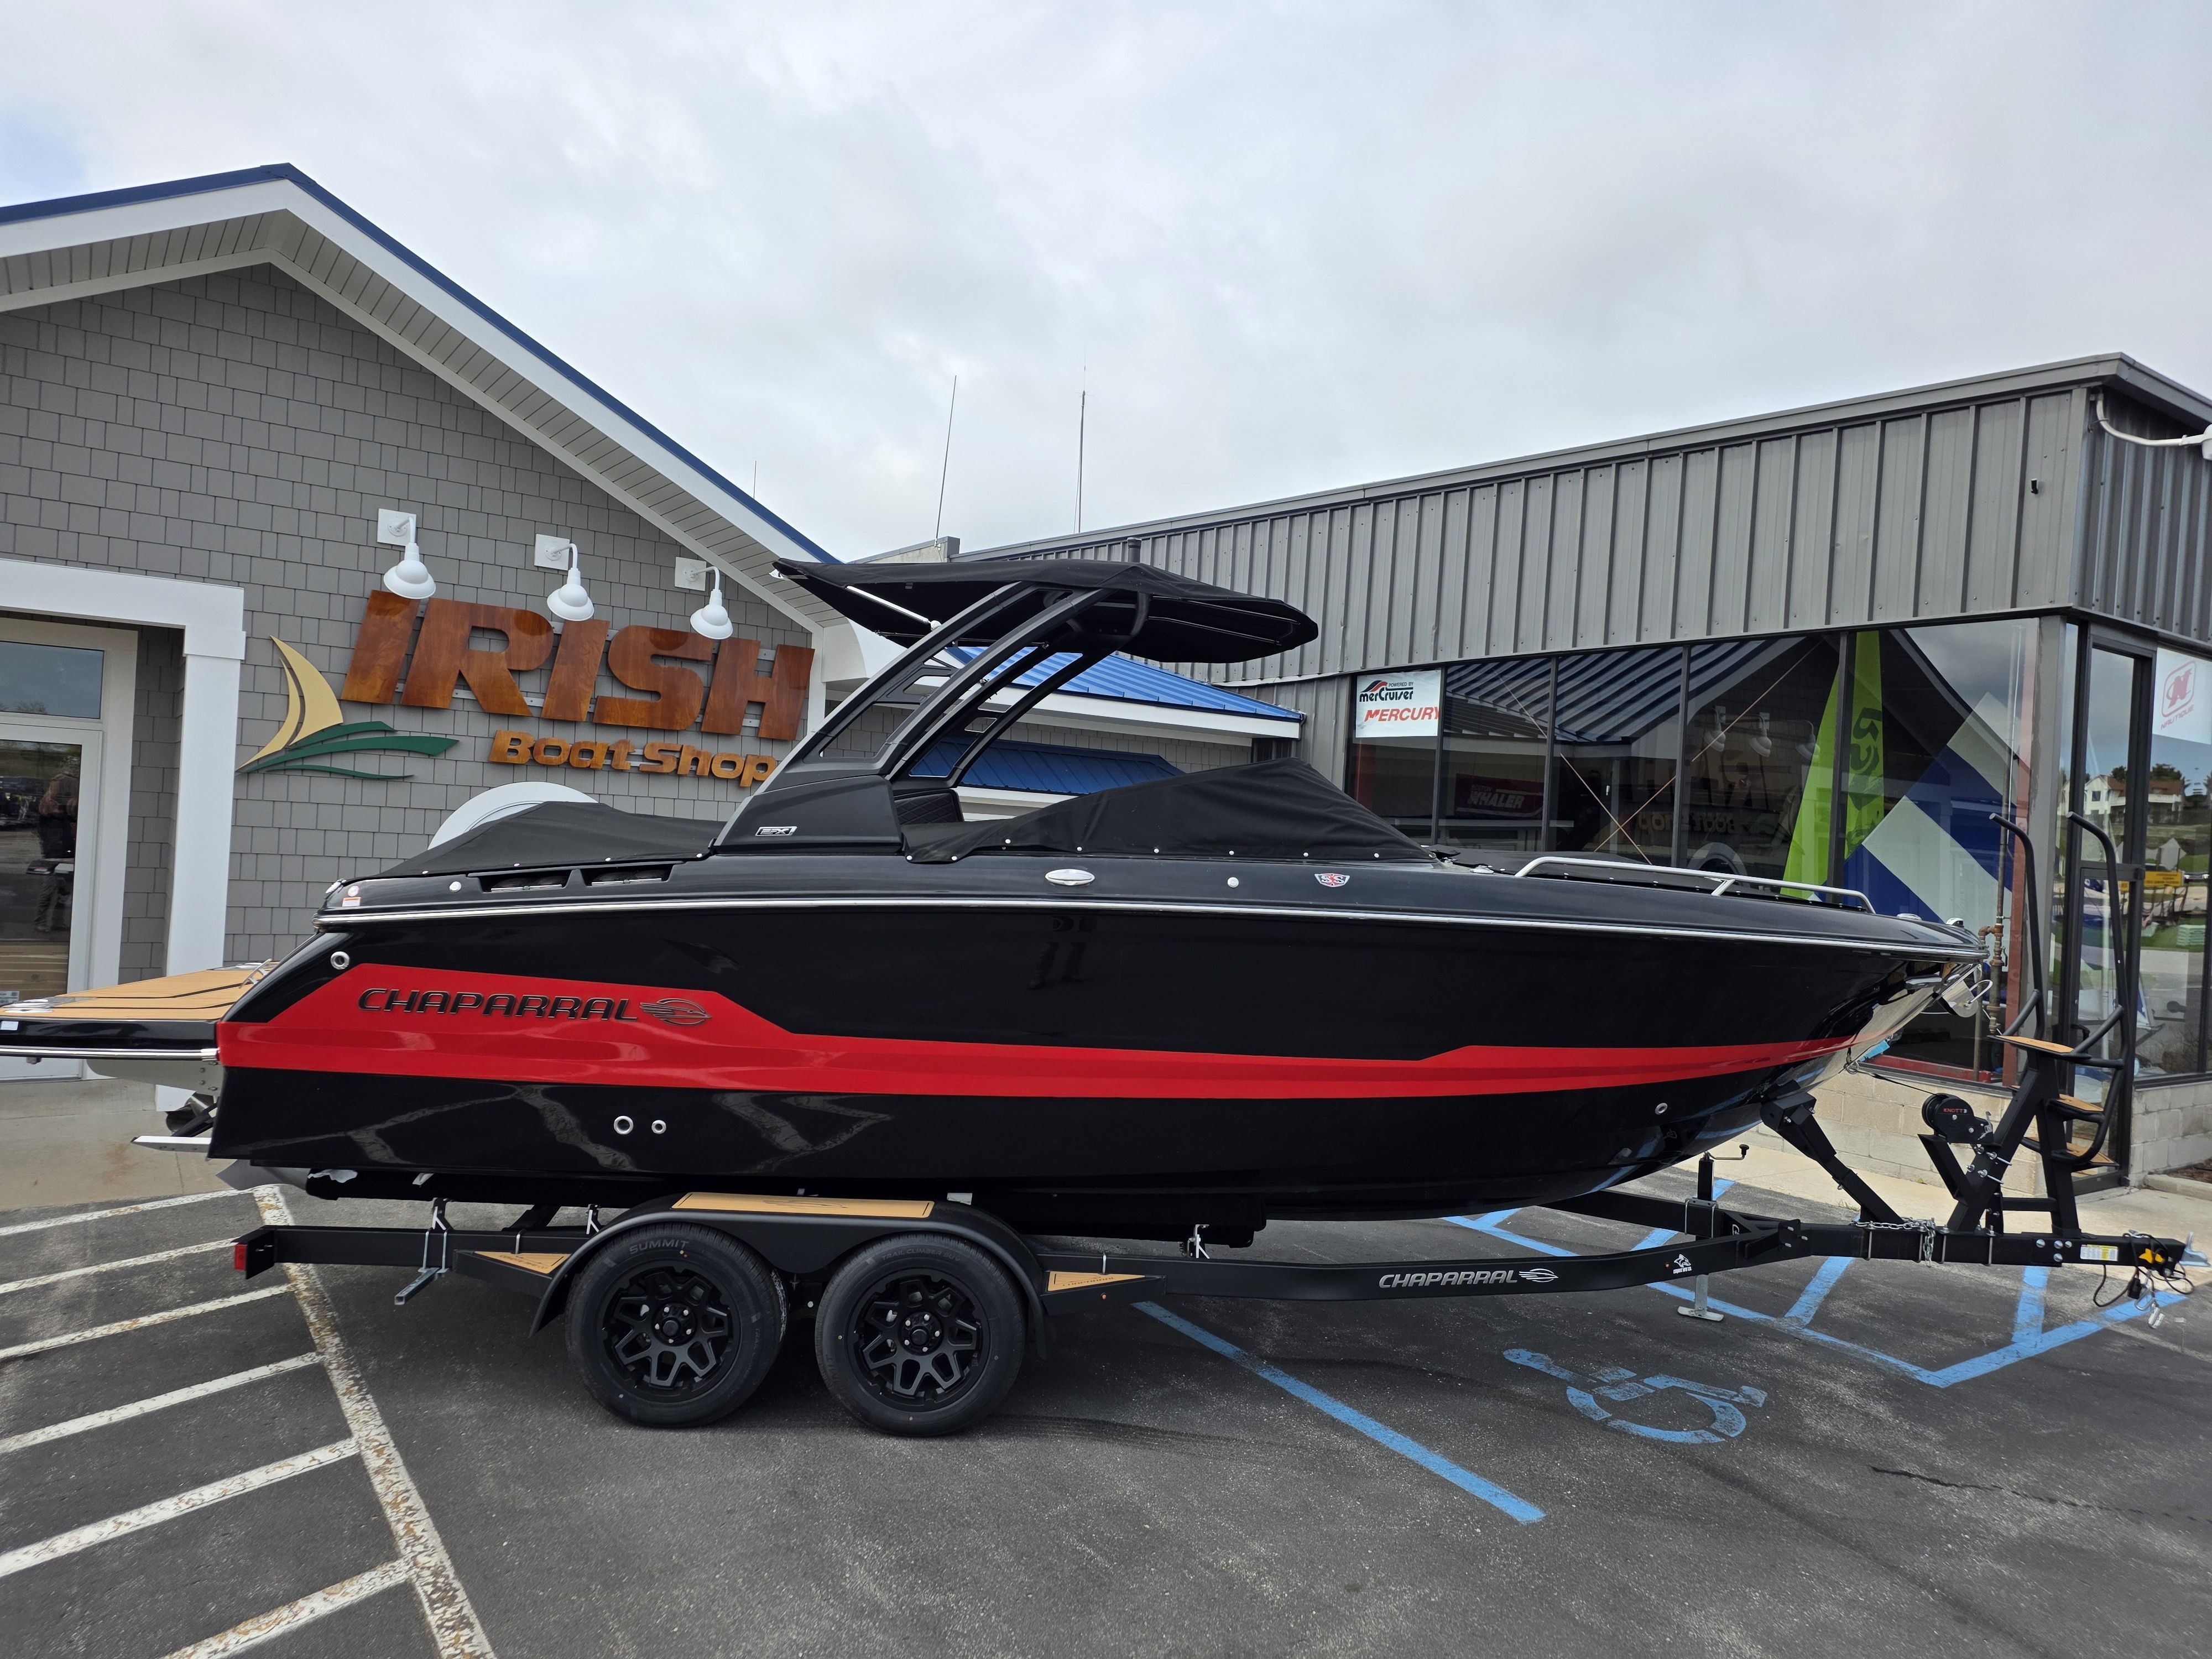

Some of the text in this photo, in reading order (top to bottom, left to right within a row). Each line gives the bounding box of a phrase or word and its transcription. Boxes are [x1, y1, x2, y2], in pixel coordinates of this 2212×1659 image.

[341, 589, 815, 740] IRISH
[489, 729, 776, 787] Boat Shop
[1467, 790, 1525, 809] WHALER
[357, 988, 638, 1021] CHAPARRAL
[630, 1239, 690, 1254] SUMMIT
[881, 1251, 905, 1260] TRAIL
[1379, 1270, 1518, 1288] CHAPARRAL
